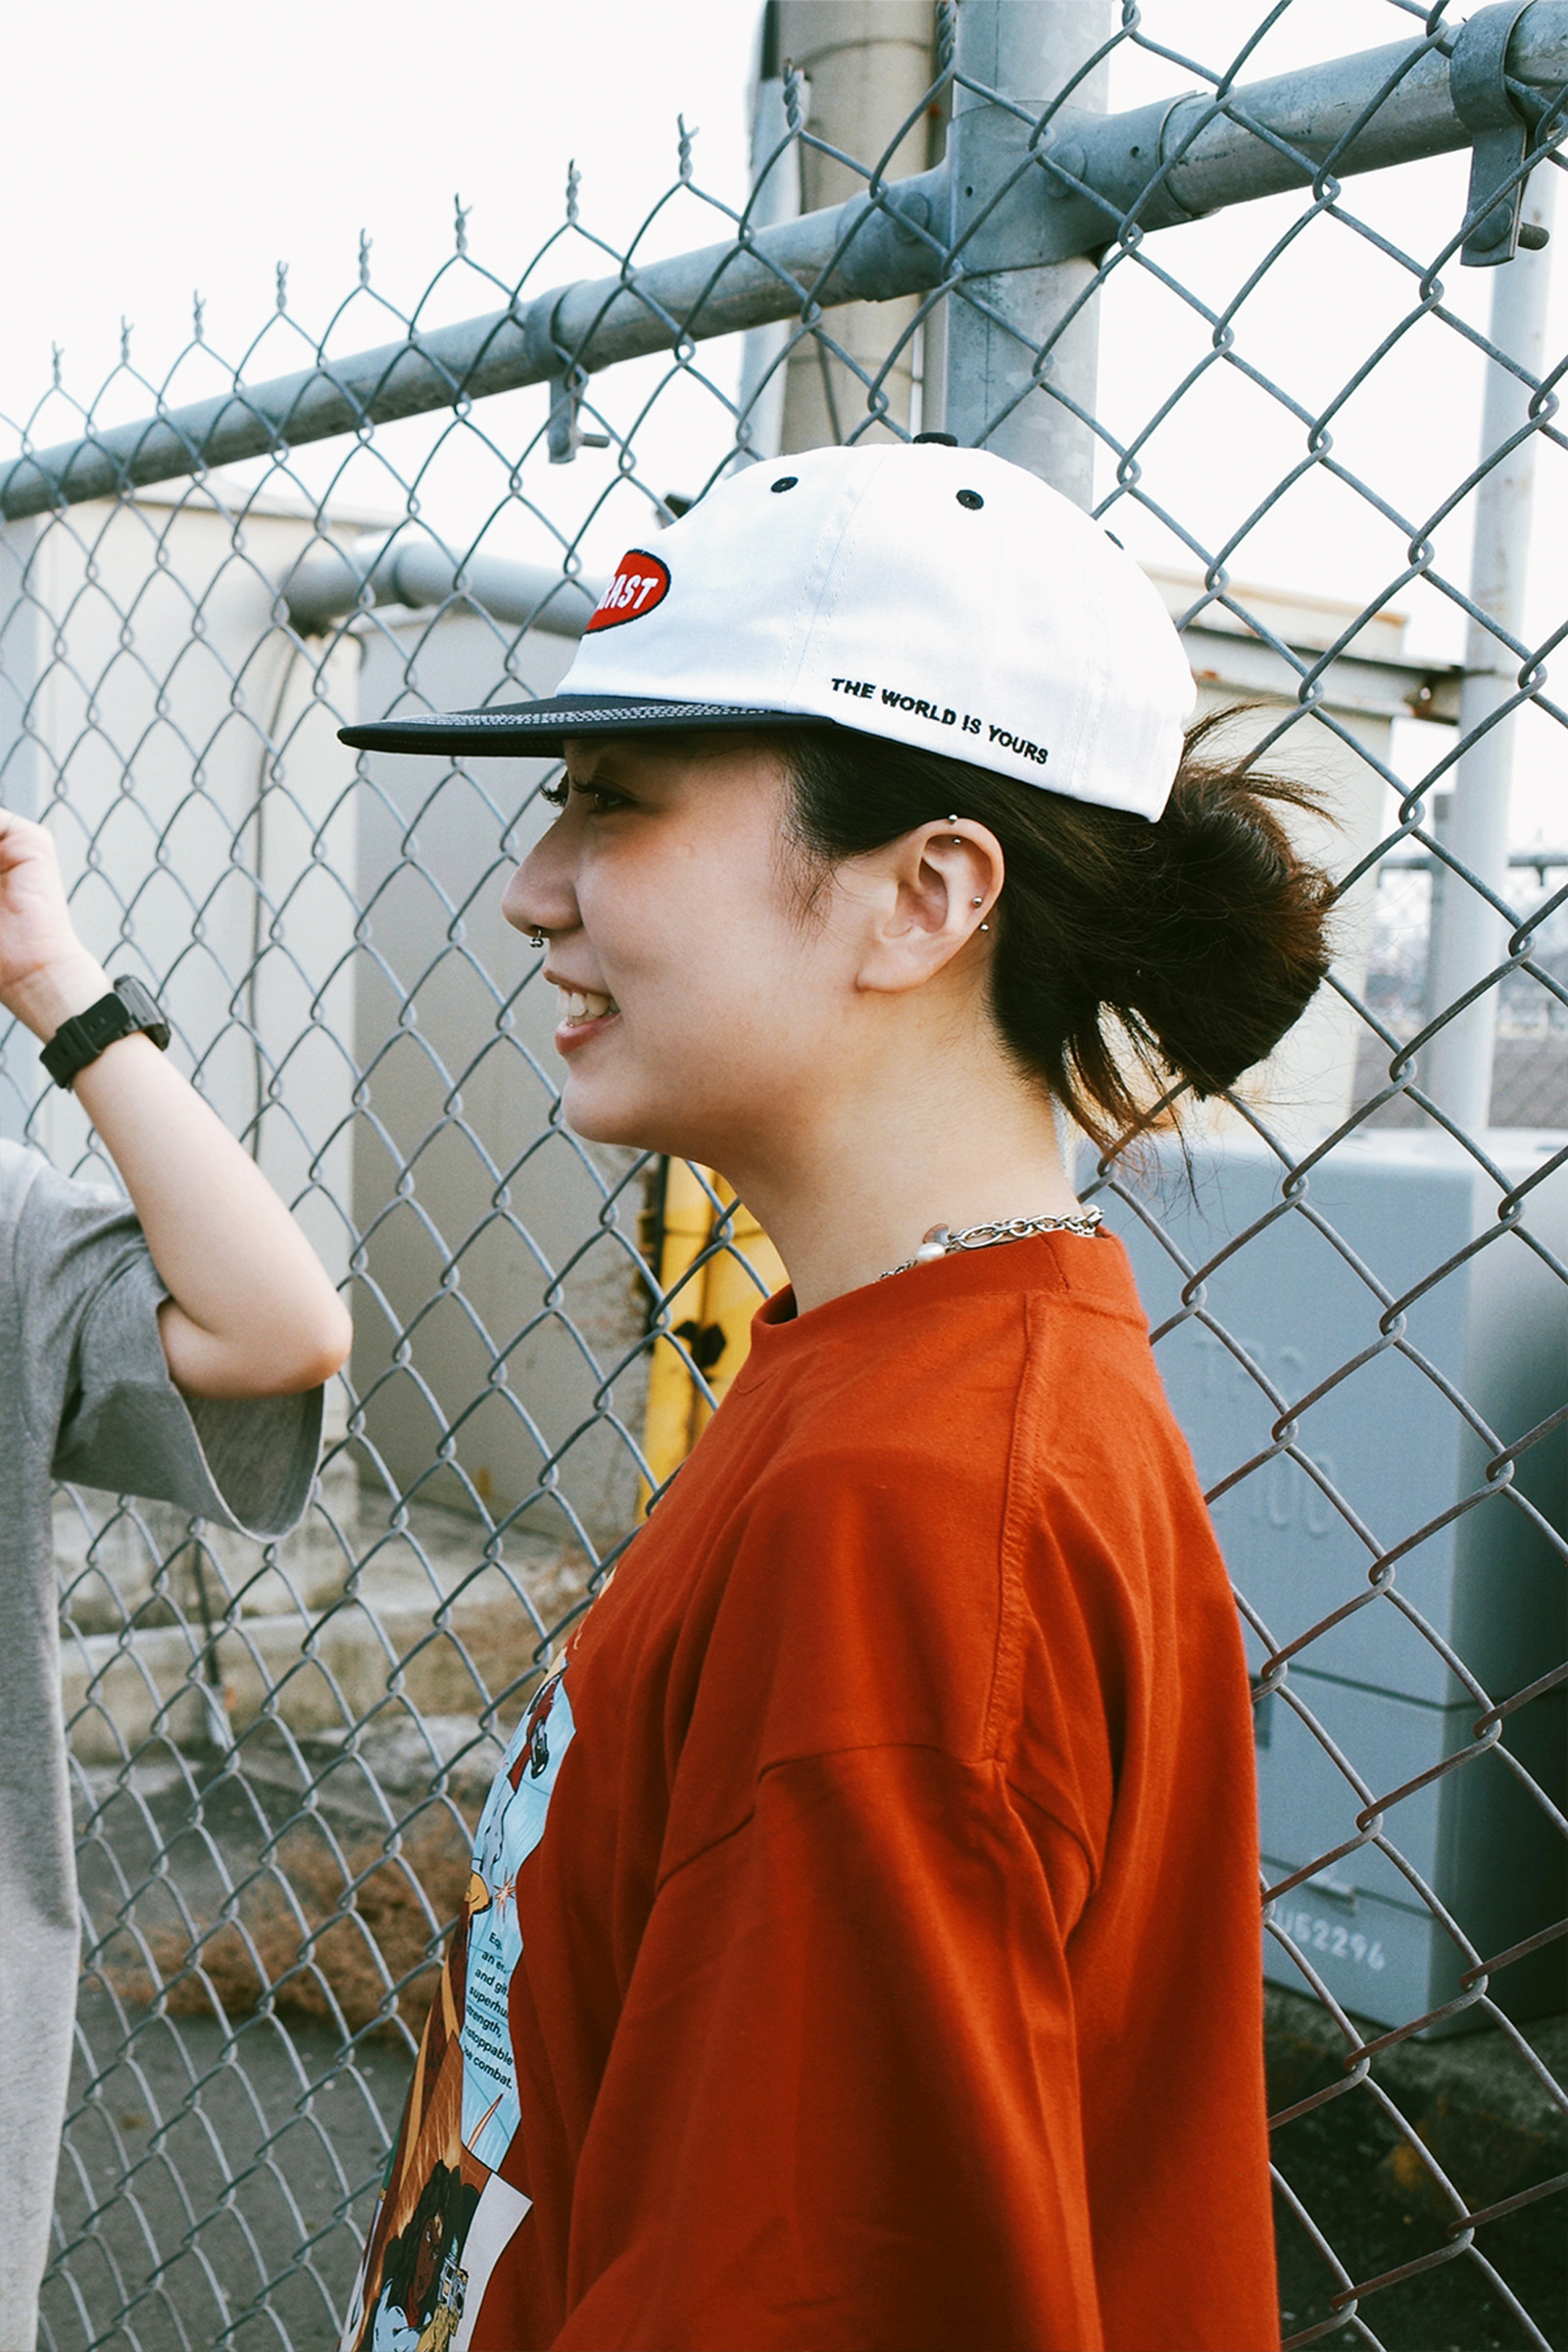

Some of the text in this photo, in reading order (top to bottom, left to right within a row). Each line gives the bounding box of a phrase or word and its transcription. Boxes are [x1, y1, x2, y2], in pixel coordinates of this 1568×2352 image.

[832, 678, 1049, 764] THE WORLD IS YOURS
[481, 1951, 495, 1965] an
[474, 1968, 496, 1986] and
[469, 1985, 509, 2019] superhu
[473, 2056, 513, 2089] combat.
